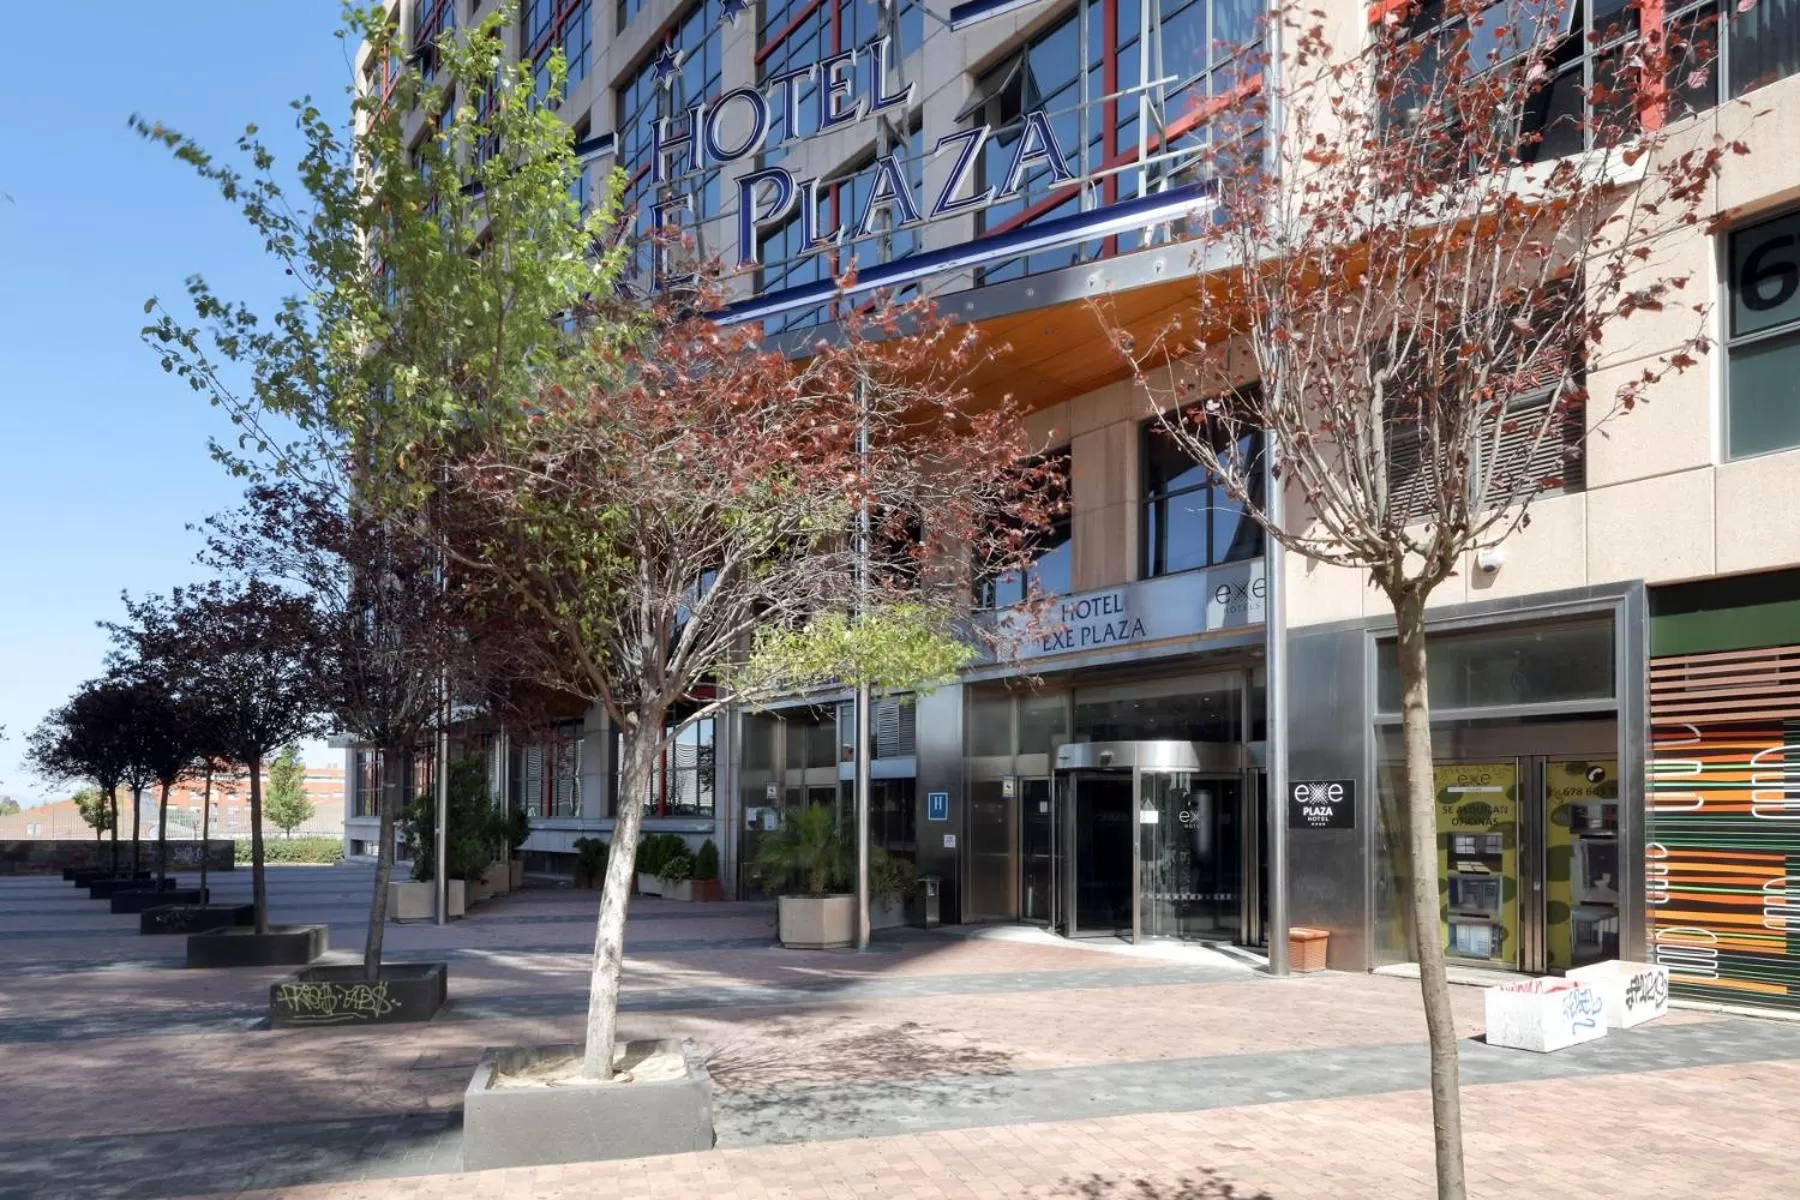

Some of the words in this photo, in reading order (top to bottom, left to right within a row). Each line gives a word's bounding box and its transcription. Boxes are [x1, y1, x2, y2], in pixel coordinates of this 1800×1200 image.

[650, 35, 916, 186] HOTEL
[733, 111, 1078, 271] PLAZA
[1741, 232, 1800, 311] 6
[1062, 594, 1124, 622] HOTEL
[1043, 629, 1075, 652] EXE
[1081, 618, 1147, 646] PLAZA
[1294, 783, 1344, 804] exe
[1303, 806, 1333, 816] PLAZA
